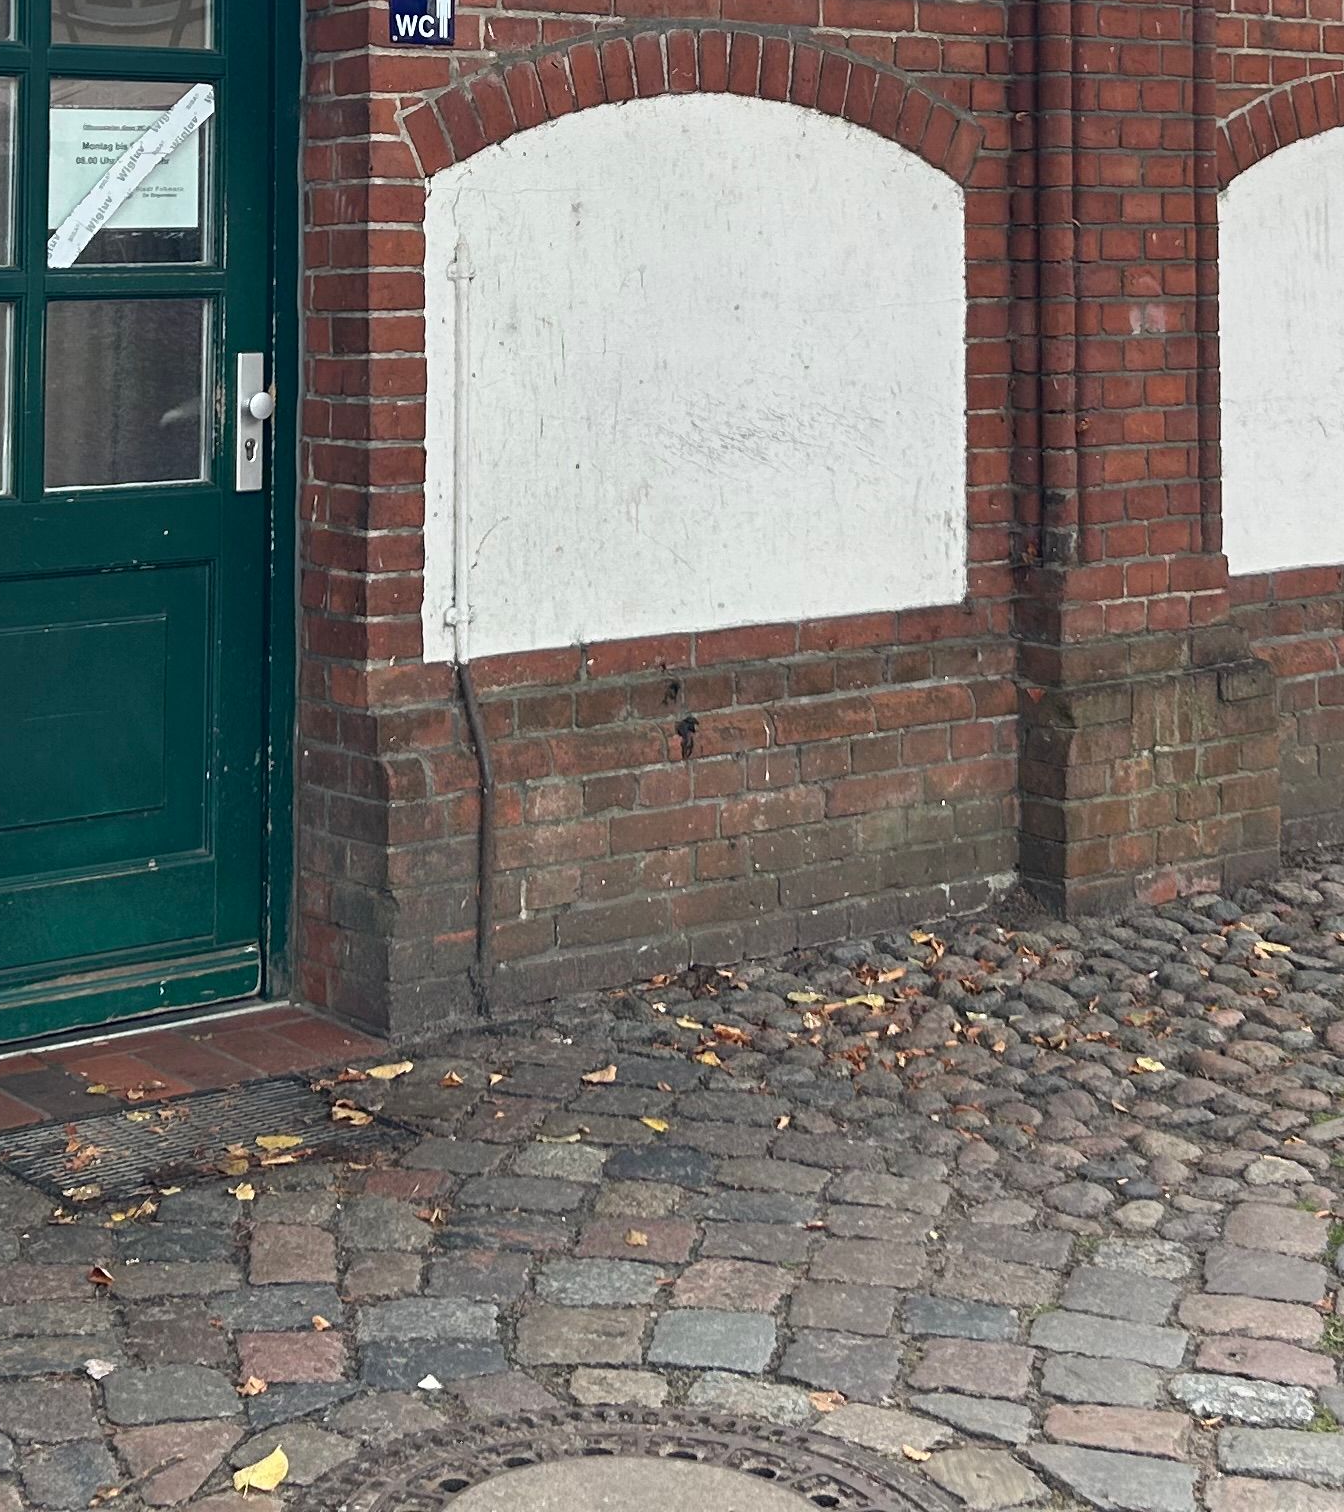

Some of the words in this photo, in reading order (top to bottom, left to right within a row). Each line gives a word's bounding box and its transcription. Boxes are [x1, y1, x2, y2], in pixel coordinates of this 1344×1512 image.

[395, 13, 435, 38] WC
[116, 145, 144, 182] Wigluv
[86, 195, 113, 233] Wigluv
